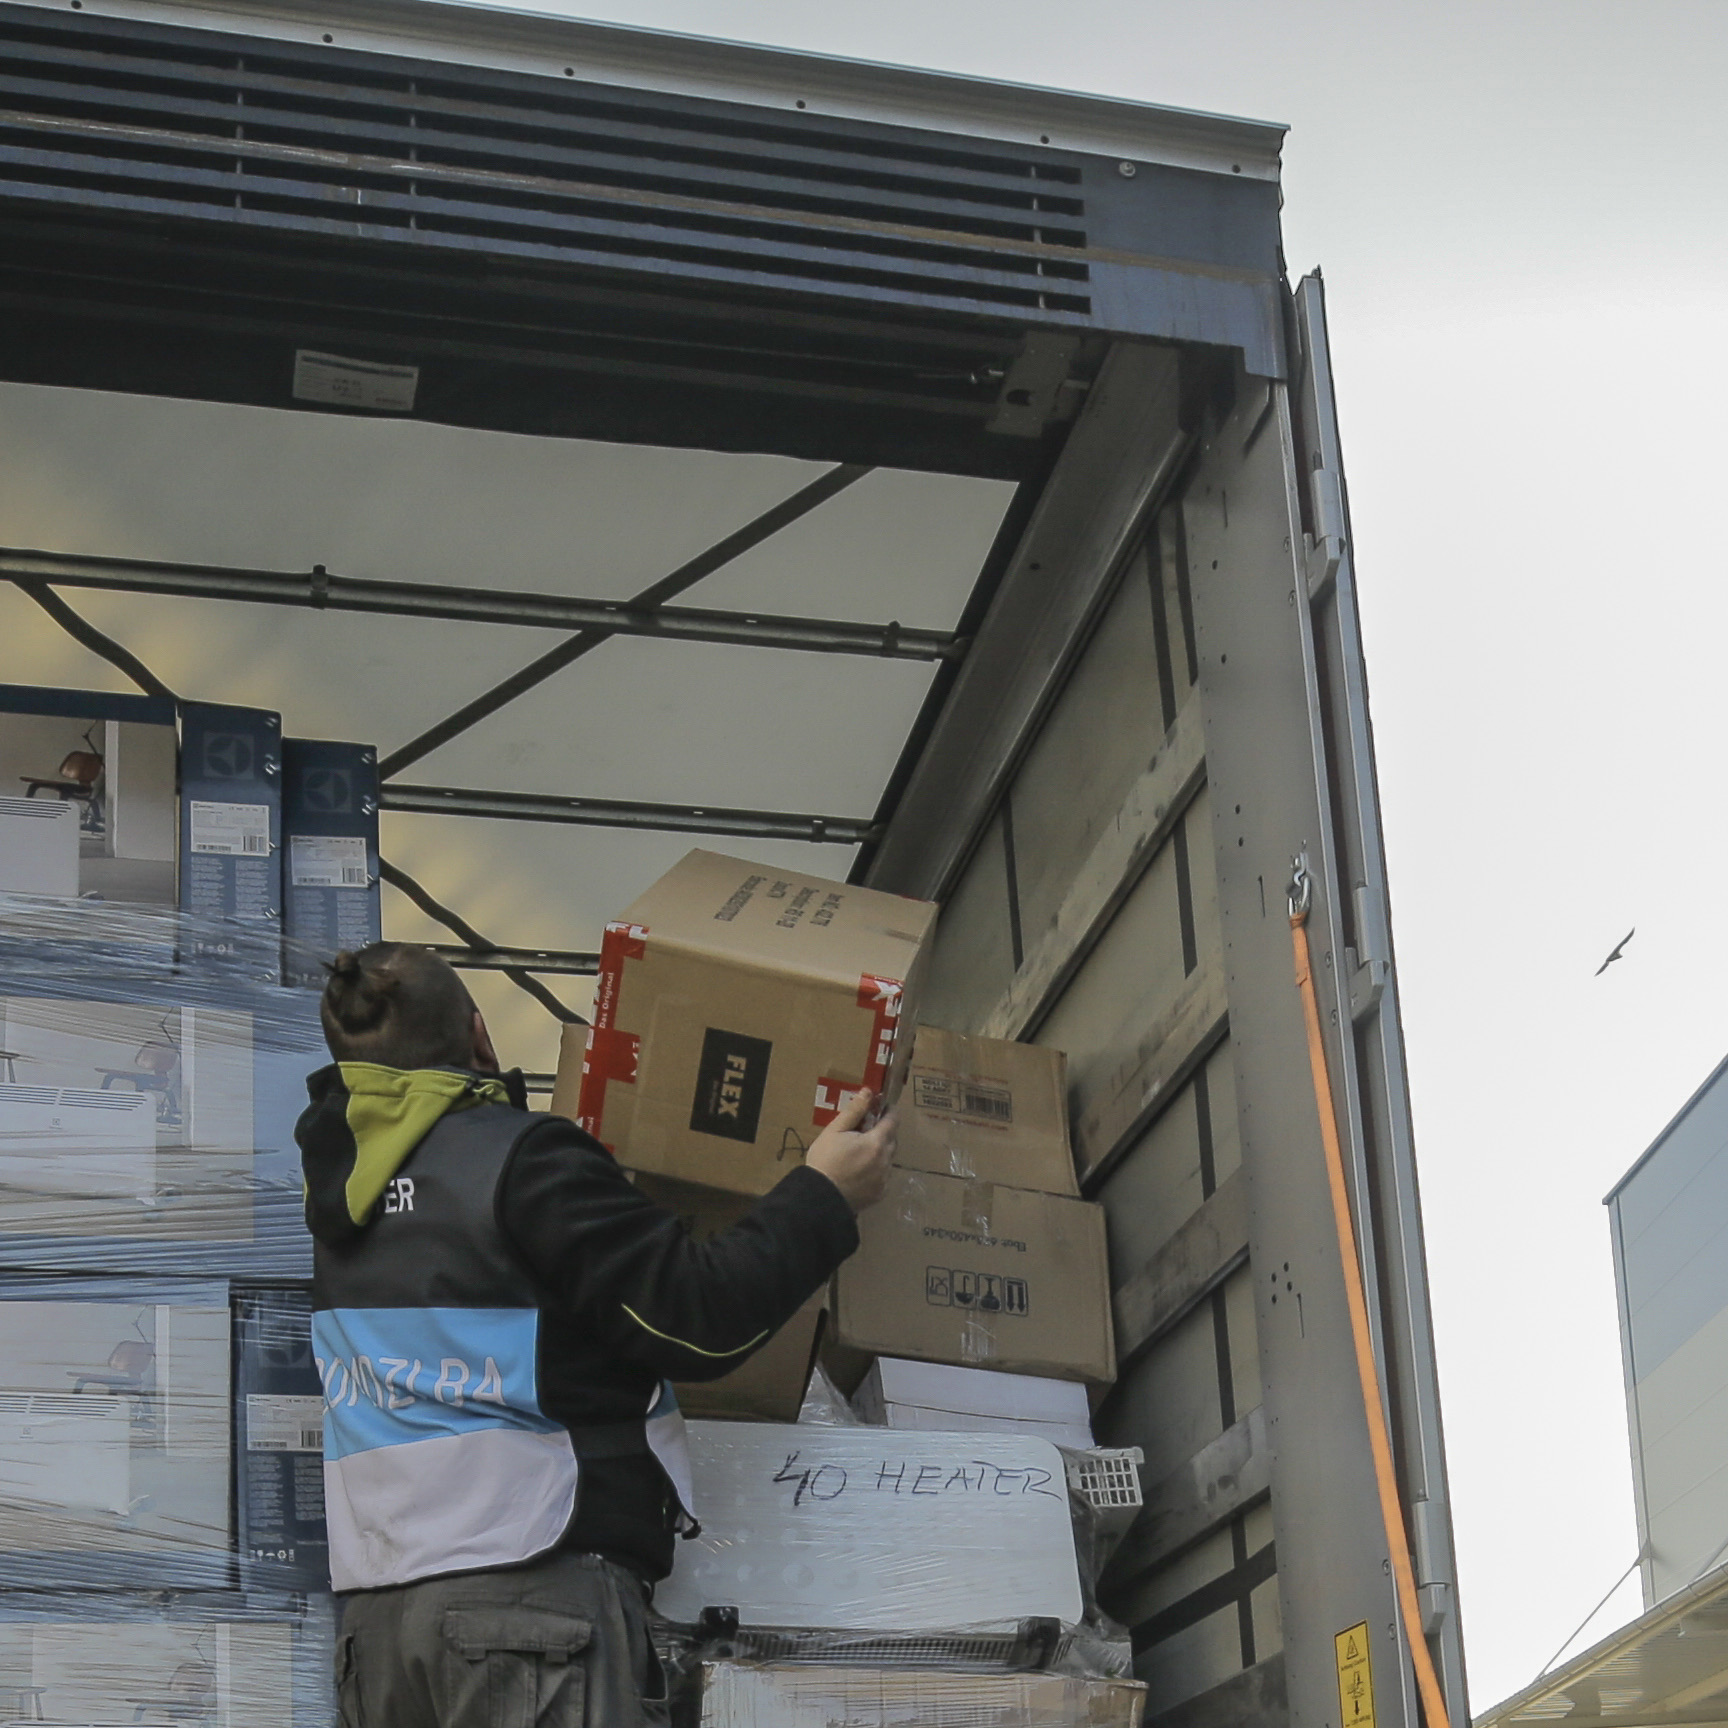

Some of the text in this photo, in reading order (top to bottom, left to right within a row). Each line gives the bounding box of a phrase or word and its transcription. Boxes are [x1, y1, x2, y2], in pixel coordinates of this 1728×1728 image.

[718, 1054, 747, 1118] FLEX
[772, 1451, 1062, 1506] 40 HEATER
